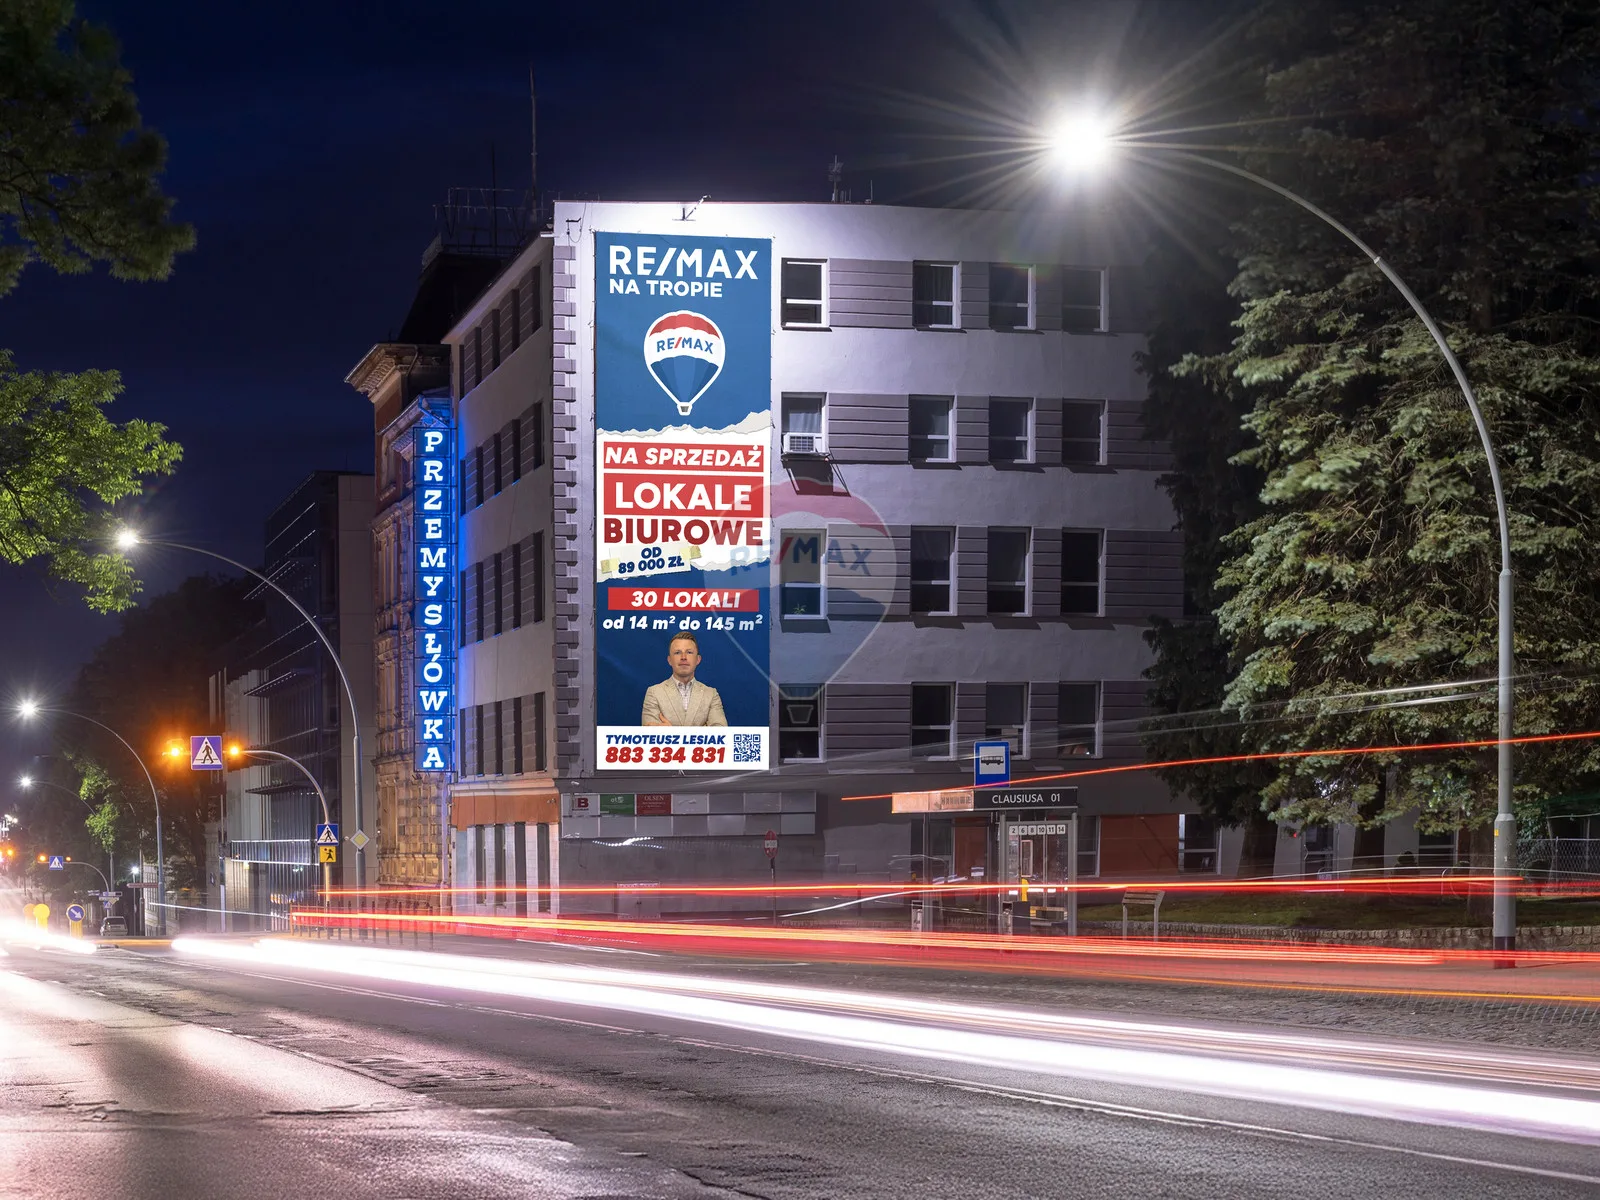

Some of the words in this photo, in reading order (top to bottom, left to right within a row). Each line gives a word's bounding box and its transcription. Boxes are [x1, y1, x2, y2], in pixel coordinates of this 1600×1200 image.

[609, 245, 758, 280] RE/MAX
[609, 278, 640, 295] NA
[646, 279, 723, 297] TROPIE
[656, 336, 714, 354] RE/MAX
[605, 447, 638, 465] NA
[645, 445, 762, 467] SPRZEDAŻ
[615, 481, 752, 511] LOKALE
[604, 517, 763, 546] BIUROWE
[641, 547, 662, 559] OD
[618, 562, 634, 574] 89
[638, 558, 665, 572] 000
[668, 555, 685, 568] ZŁ
[631, 591, 658, 608] 30
[663, 591, 741, 608] LOKALI
[602, 615, 625, 630] od
[629, 615, 648, 630] 14
[679, 616, 700, 631] do
[705, 617, 735, 631] 145
[605, 734, 680, 745] TYMOTEUSZ
[682, 735, 726, 745] LESIAK
[605, 747, 643, 763] 883
[648, 747, 686, 763] 334
[691, 747, 726, 763] 831
[992, 794, 1043, 804] CLAUSIUSA
[1051, 793, 1061, 802] 01
